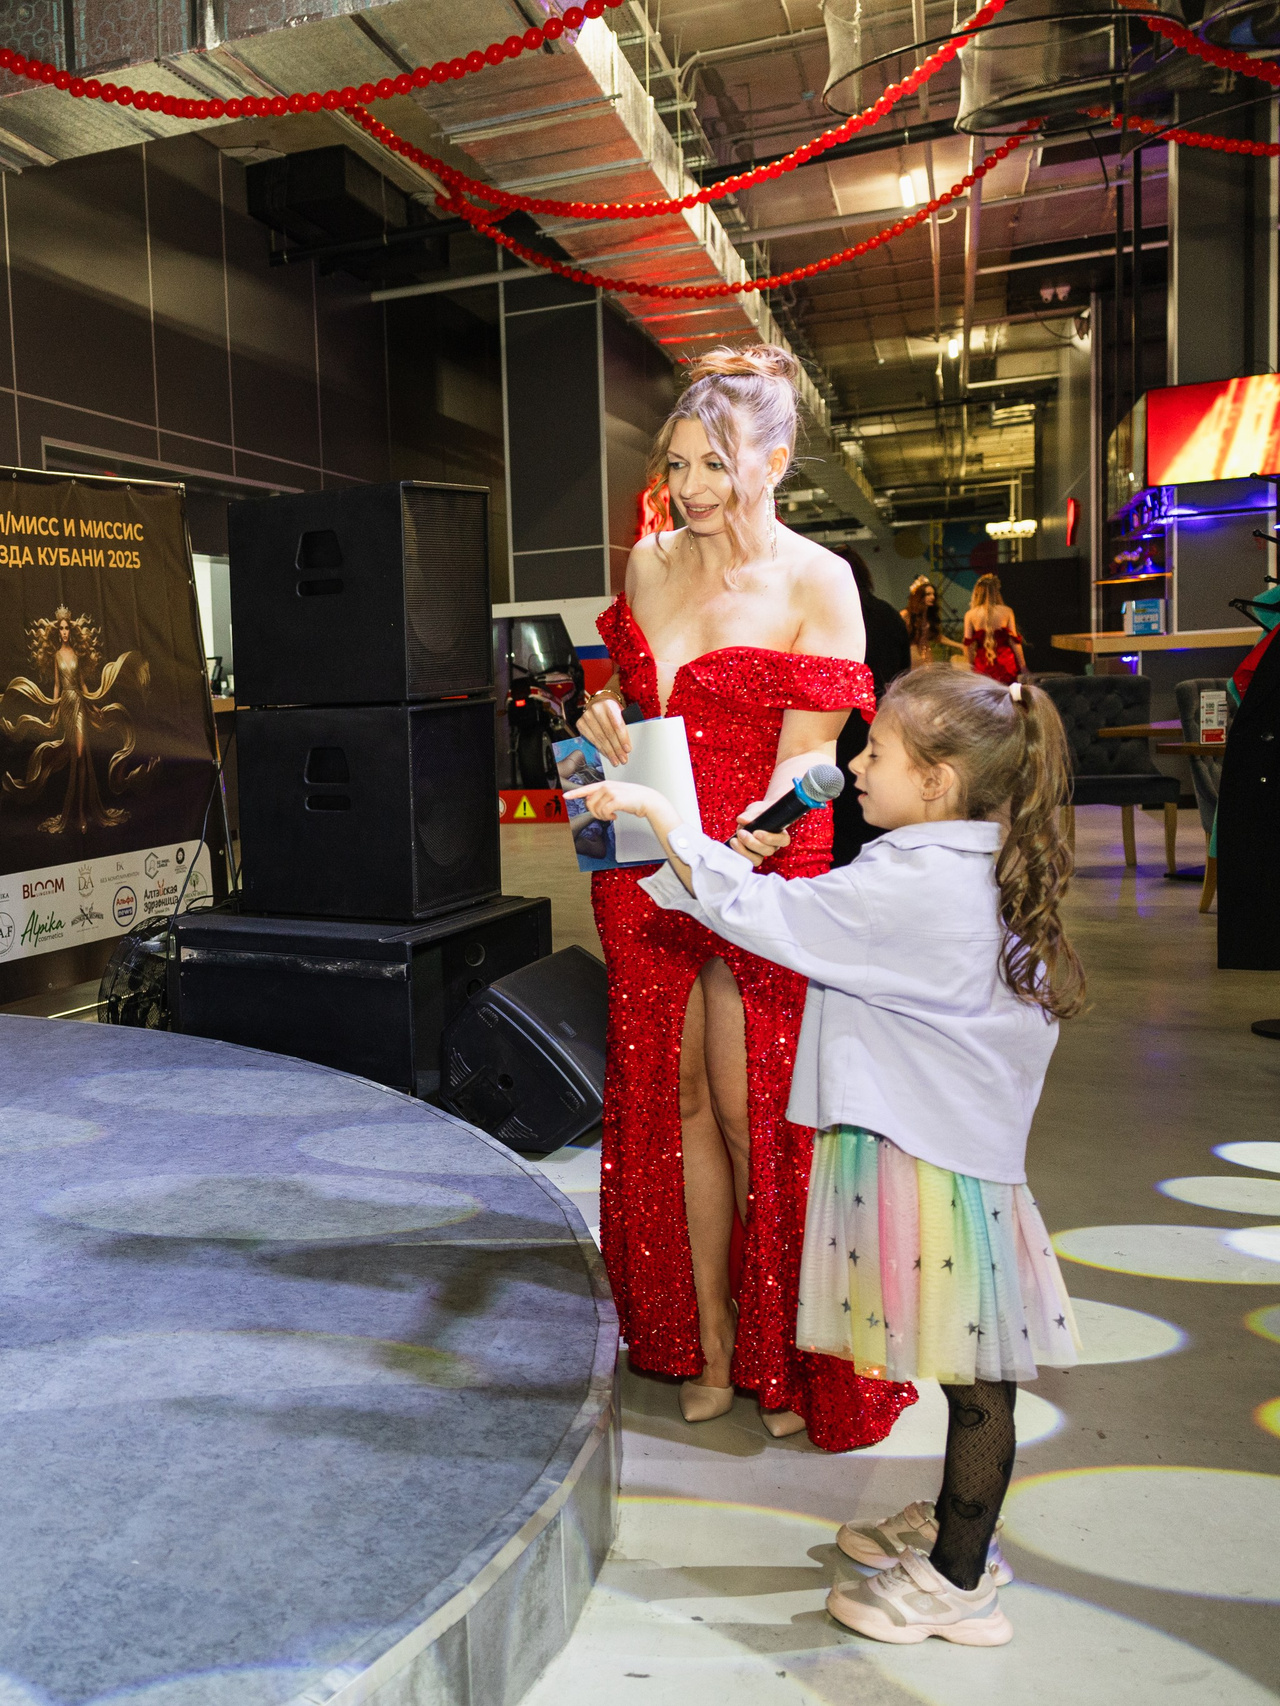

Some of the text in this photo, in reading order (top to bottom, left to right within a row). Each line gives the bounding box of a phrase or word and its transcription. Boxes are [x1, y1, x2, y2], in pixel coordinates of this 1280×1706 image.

[63, 518, 76, 537] И
[79, 519, 144, 541] МИССИС
[37, 546, 105, 567] КУБАНИ
[107, 549, 141, 569] 2025
[23, 877, 65, 899] BLOOM
[116, 896, 134, 905] Альфа
[118, 908, 133, 916] news
[21, 910, 66, 948] Alpika
[38, 933, 64, 942] cosmetics
